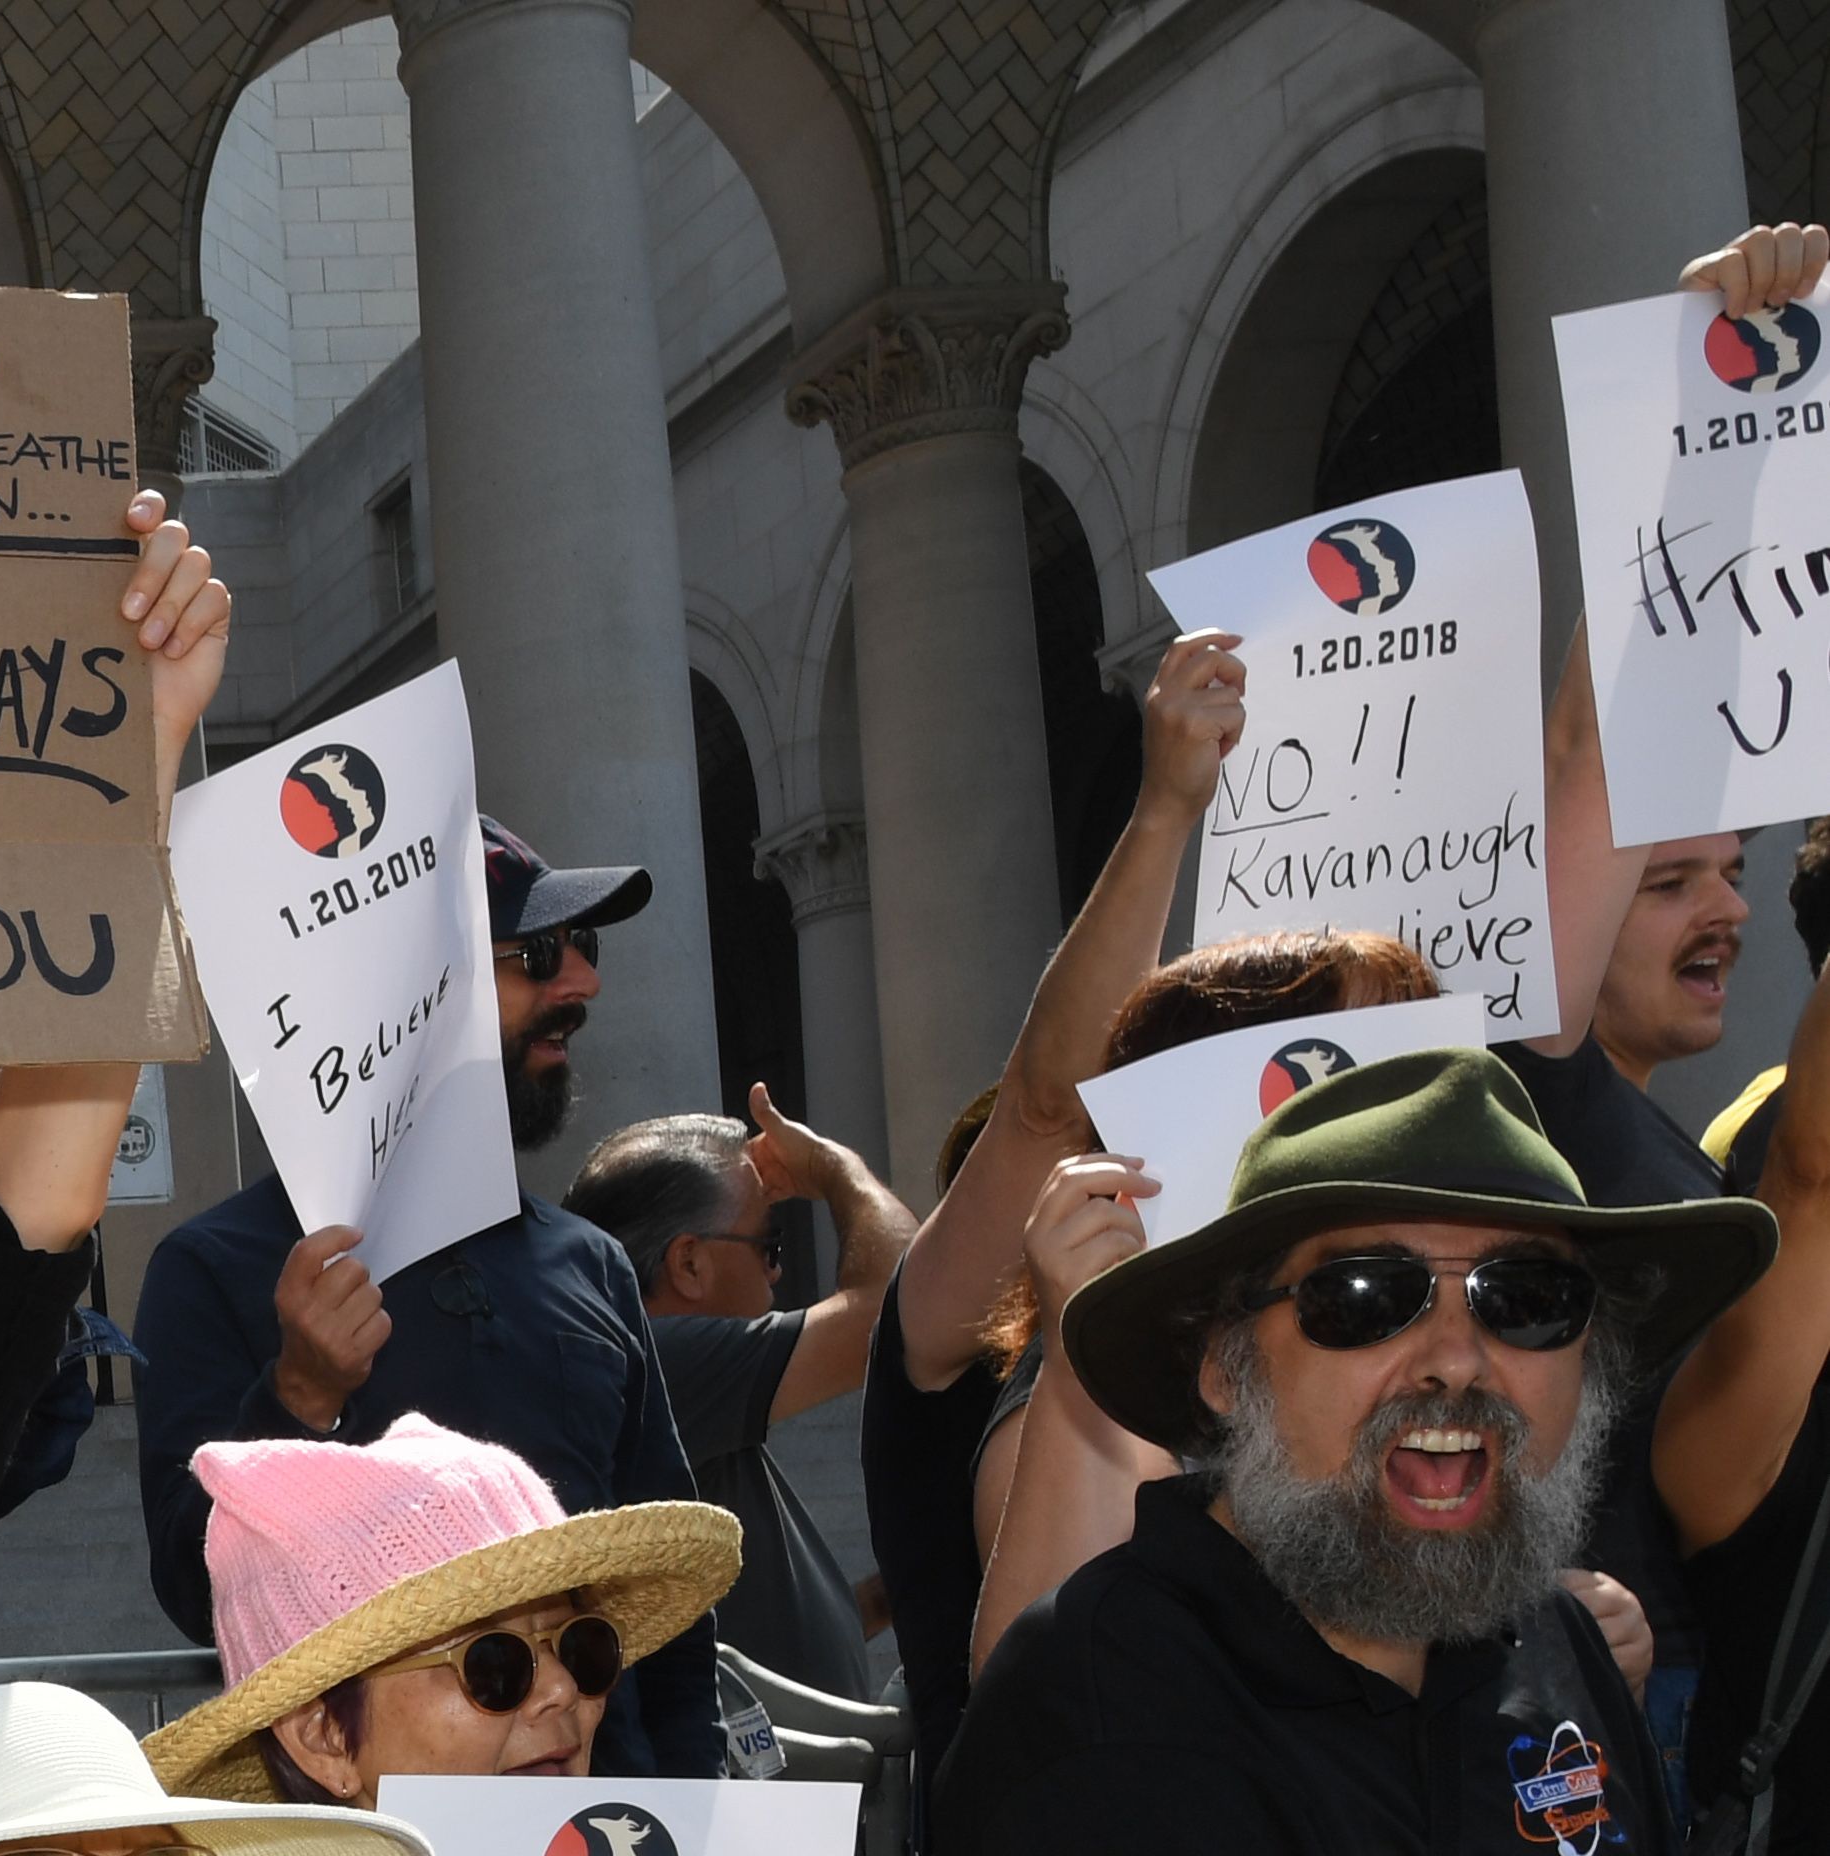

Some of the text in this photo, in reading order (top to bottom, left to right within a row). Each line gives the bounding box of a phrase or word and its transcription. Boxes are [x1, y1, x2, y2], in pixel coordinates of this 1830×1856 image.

[1673, 401, 1830, 457] 1.20.20
[1290, 620, 1459, 679] 1.20.2018
[1217, 789, 1540, 913] Kavanaugh
[279, 835, 439, 941] 1.20.2018
[267, 993, 301, 1050] I
